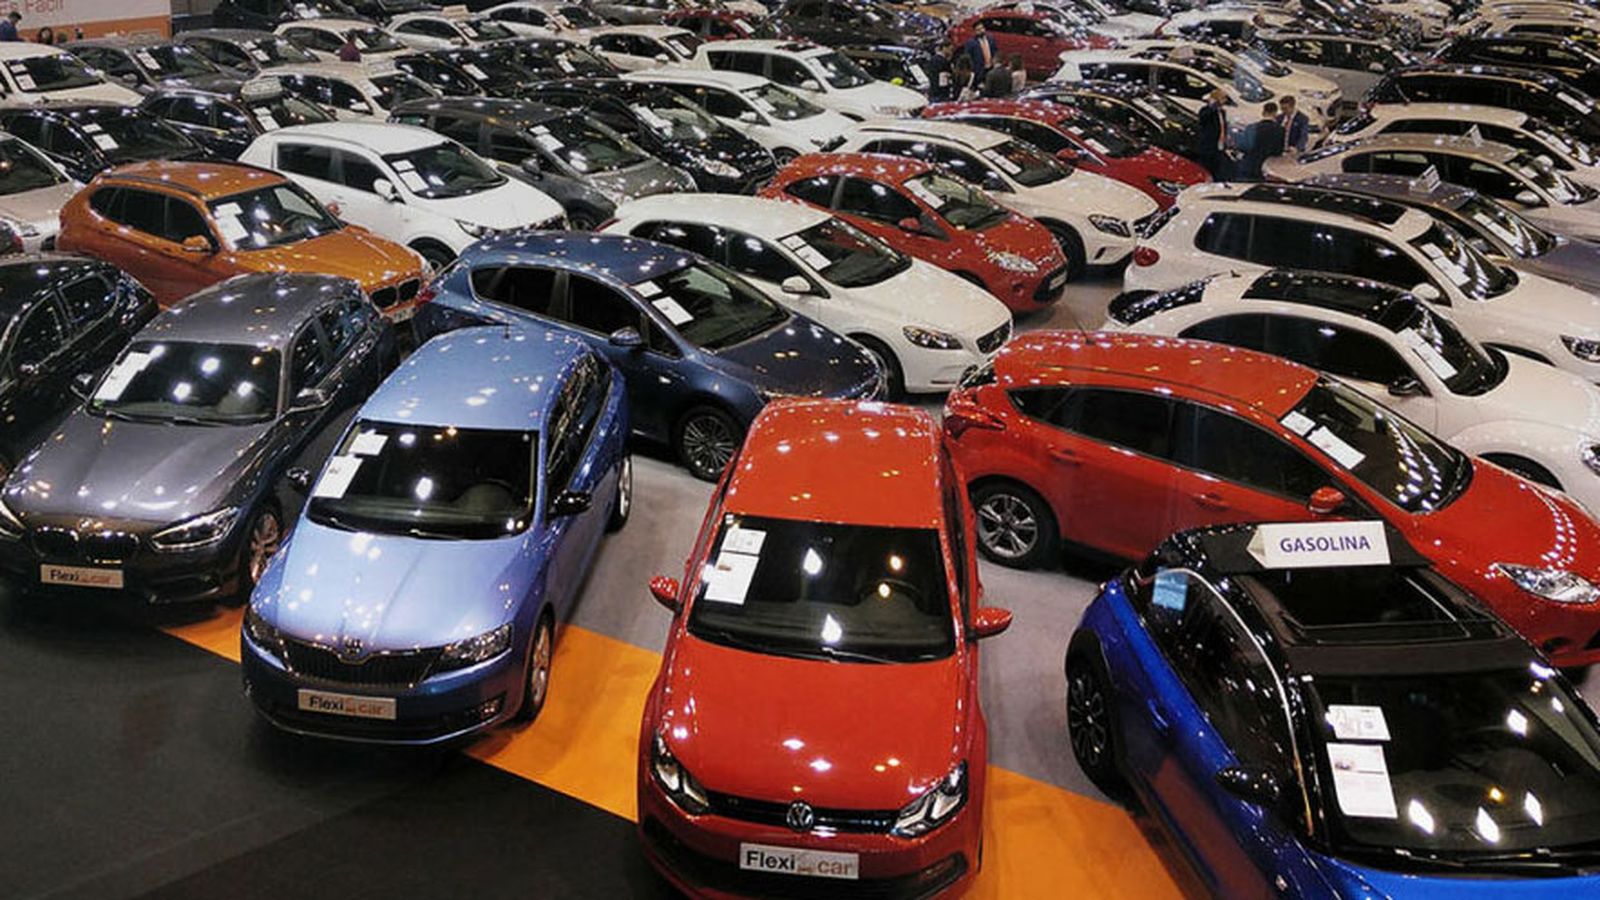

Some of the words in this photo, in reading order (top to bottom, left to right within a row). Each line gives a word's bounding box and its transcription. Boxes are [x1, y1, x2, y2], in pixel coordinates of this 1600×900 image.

[1280, 536, 1371, 553] GASOLINA
[310, 695, 344, 711] Flexi
[746, 850, 796, 870] Flexi
[817, 860, 853, 875] car
